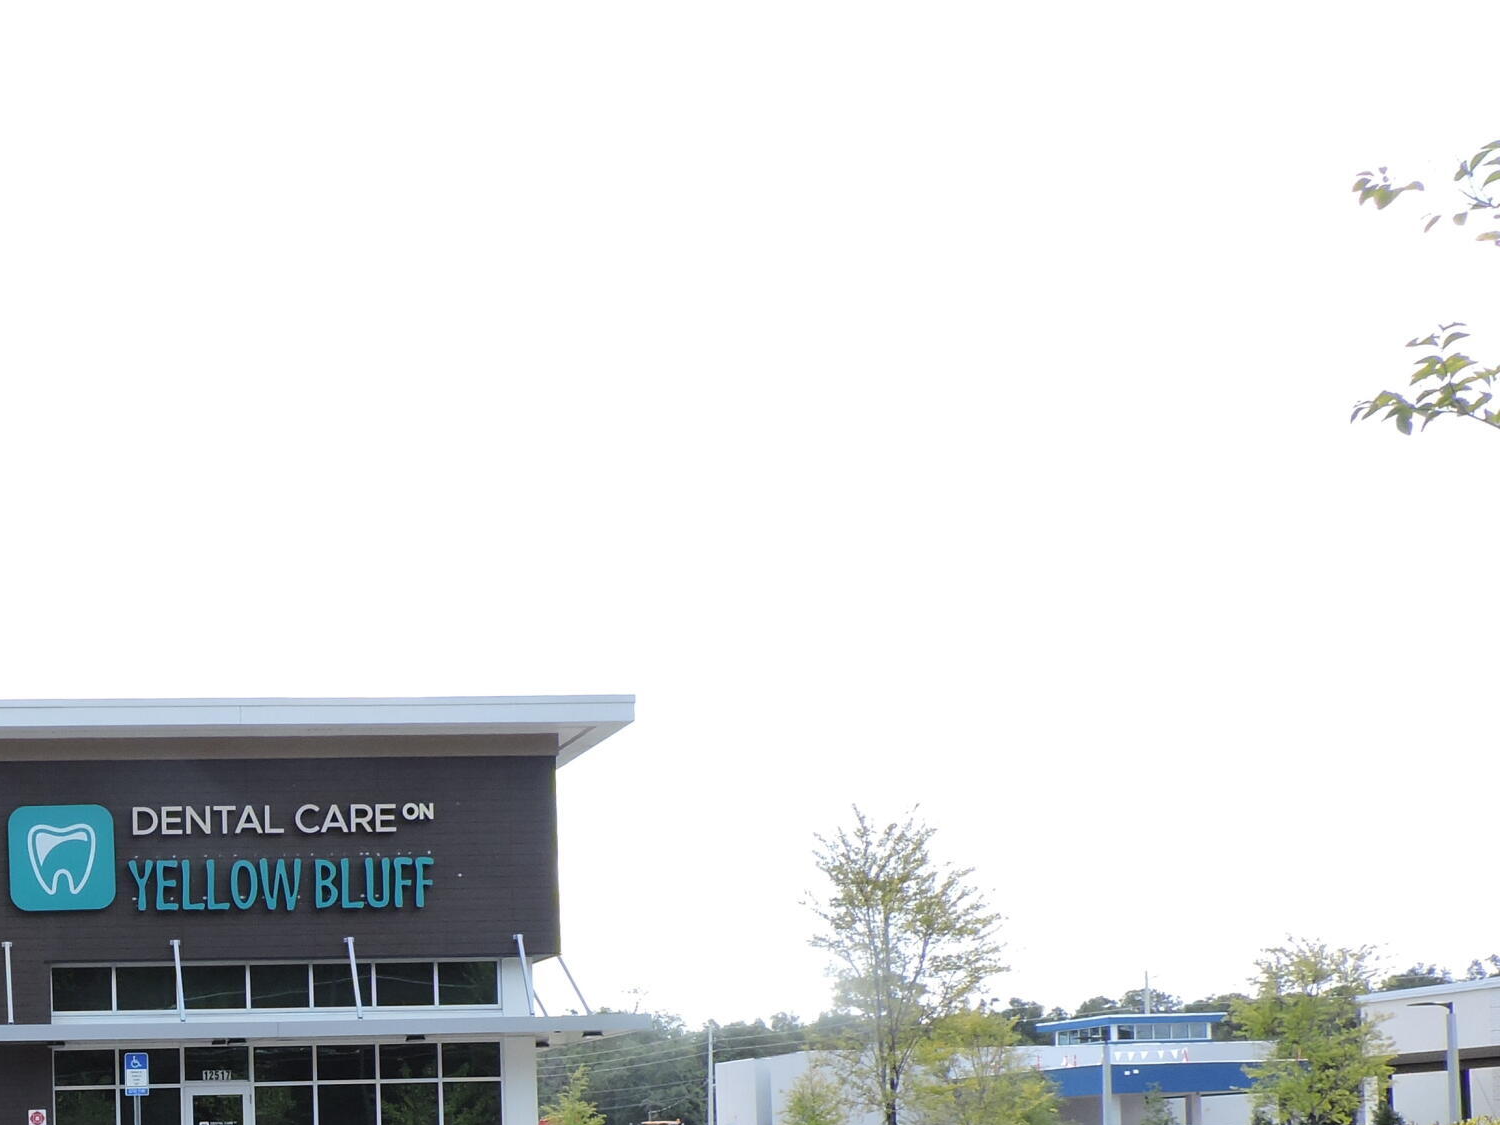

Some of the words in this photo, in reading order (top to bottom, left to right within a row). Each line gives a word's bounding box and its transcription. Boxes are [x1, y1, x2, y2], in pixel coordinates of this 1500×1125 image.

[131, 804, 285, 836] DENTAL
[294, 803, 398, 834] CARE
[402, 802, 435, 821] ON
[127, 857, 302, 911] YELLOW
[314, 856, 435, 909] BLUFF
[202, 1069, 232, 1081] 12517
